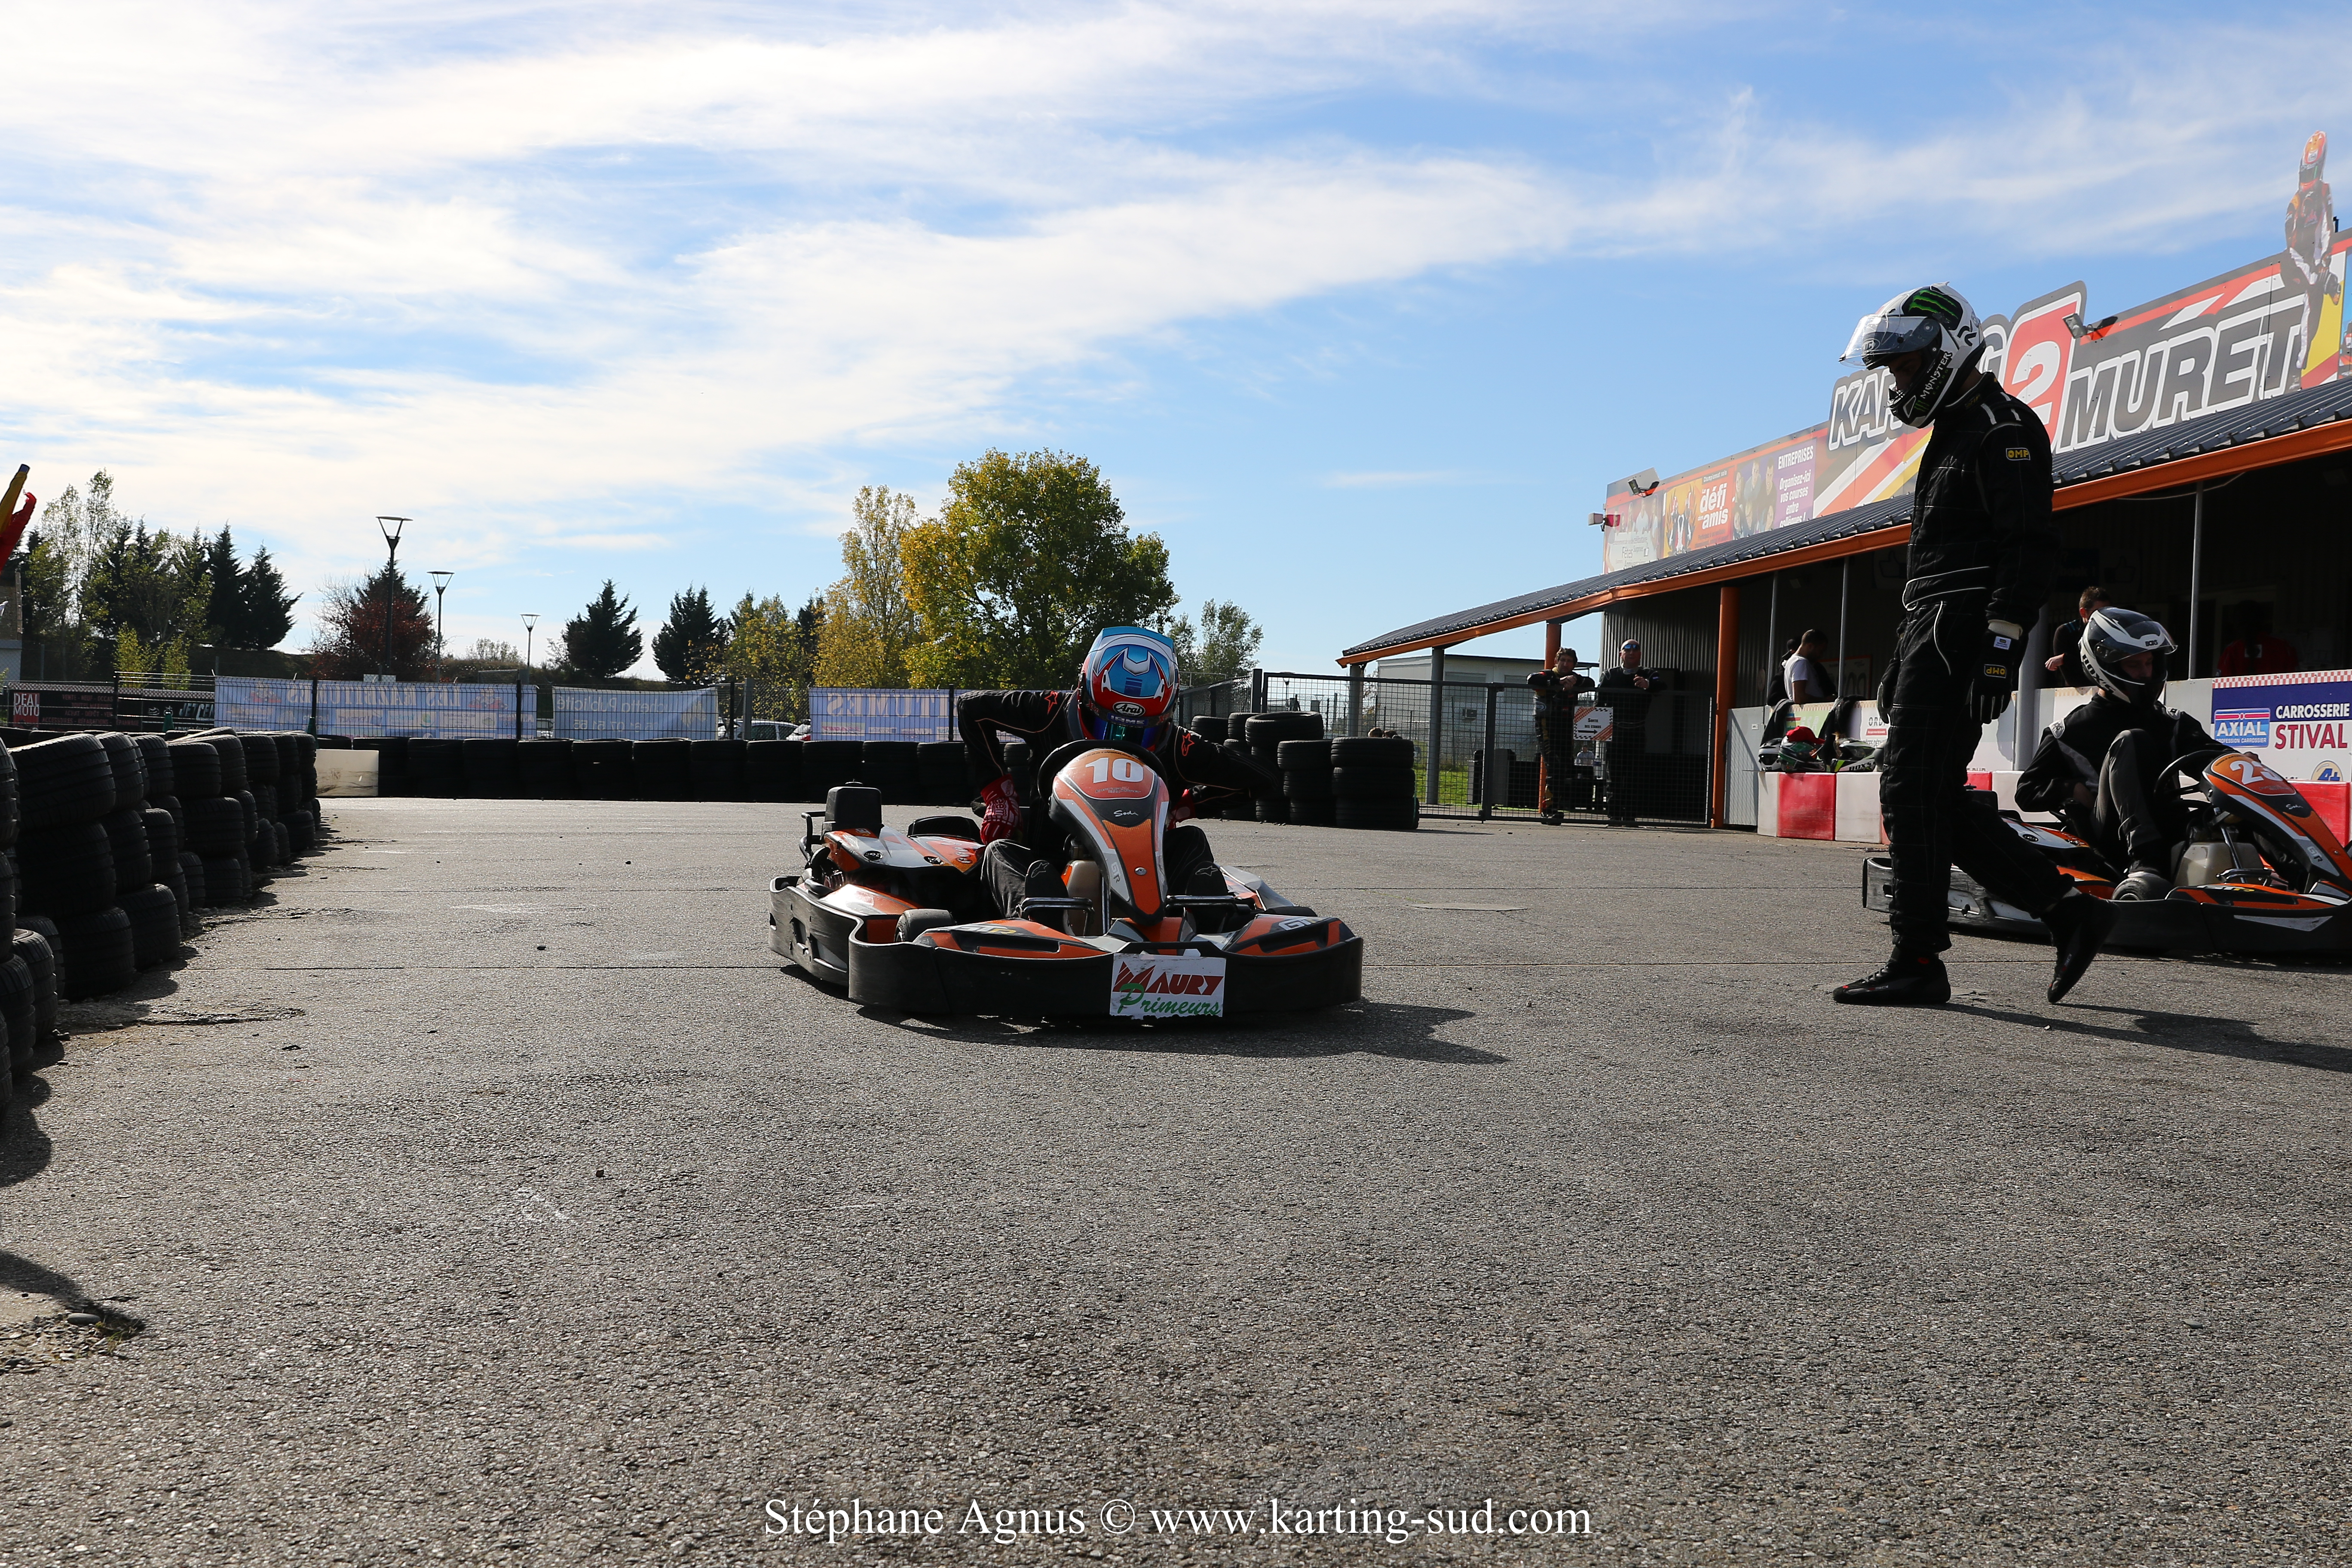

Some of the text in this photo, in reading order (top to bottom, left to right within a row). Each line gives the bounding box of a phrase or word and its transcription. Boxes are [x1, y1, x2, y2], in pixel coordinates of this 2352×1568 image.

[1920, 351, 1953, 399] MONSTER
[2055, 293, 2306, 454] MURET
[1778, 445, 1813, 470] ENTREPRISES
[2007, 449, 2029, 458] OMP
[1779, 469, 1811, 491] Organisez-ici
[1700, 483, 1727, 513] défi
[1789, 486, 1809, 500] courses
[1785, 502, 1799, 515] entre
[1702, 508, 1728, 530] amis
[1986, 667, 2005, 675] OMP
[14, 693, 40, 706] DEAL
[1117, 704, 1141, 714] Arai
[13, 705, 40, 717] MOTO
[1110, 715, 1145, 725] IAME
[2275, 703, 2350, 719] CARROSSERIE
[2217, 721, 2267, 737] AXIAL
[2275, 723, 2348, 749] STIVAL
[1084, 757, 1144, 784] 10
[1112, 961, 1224, 996] MAURY
[1118, 983, 1222, 1016] Primeurs
